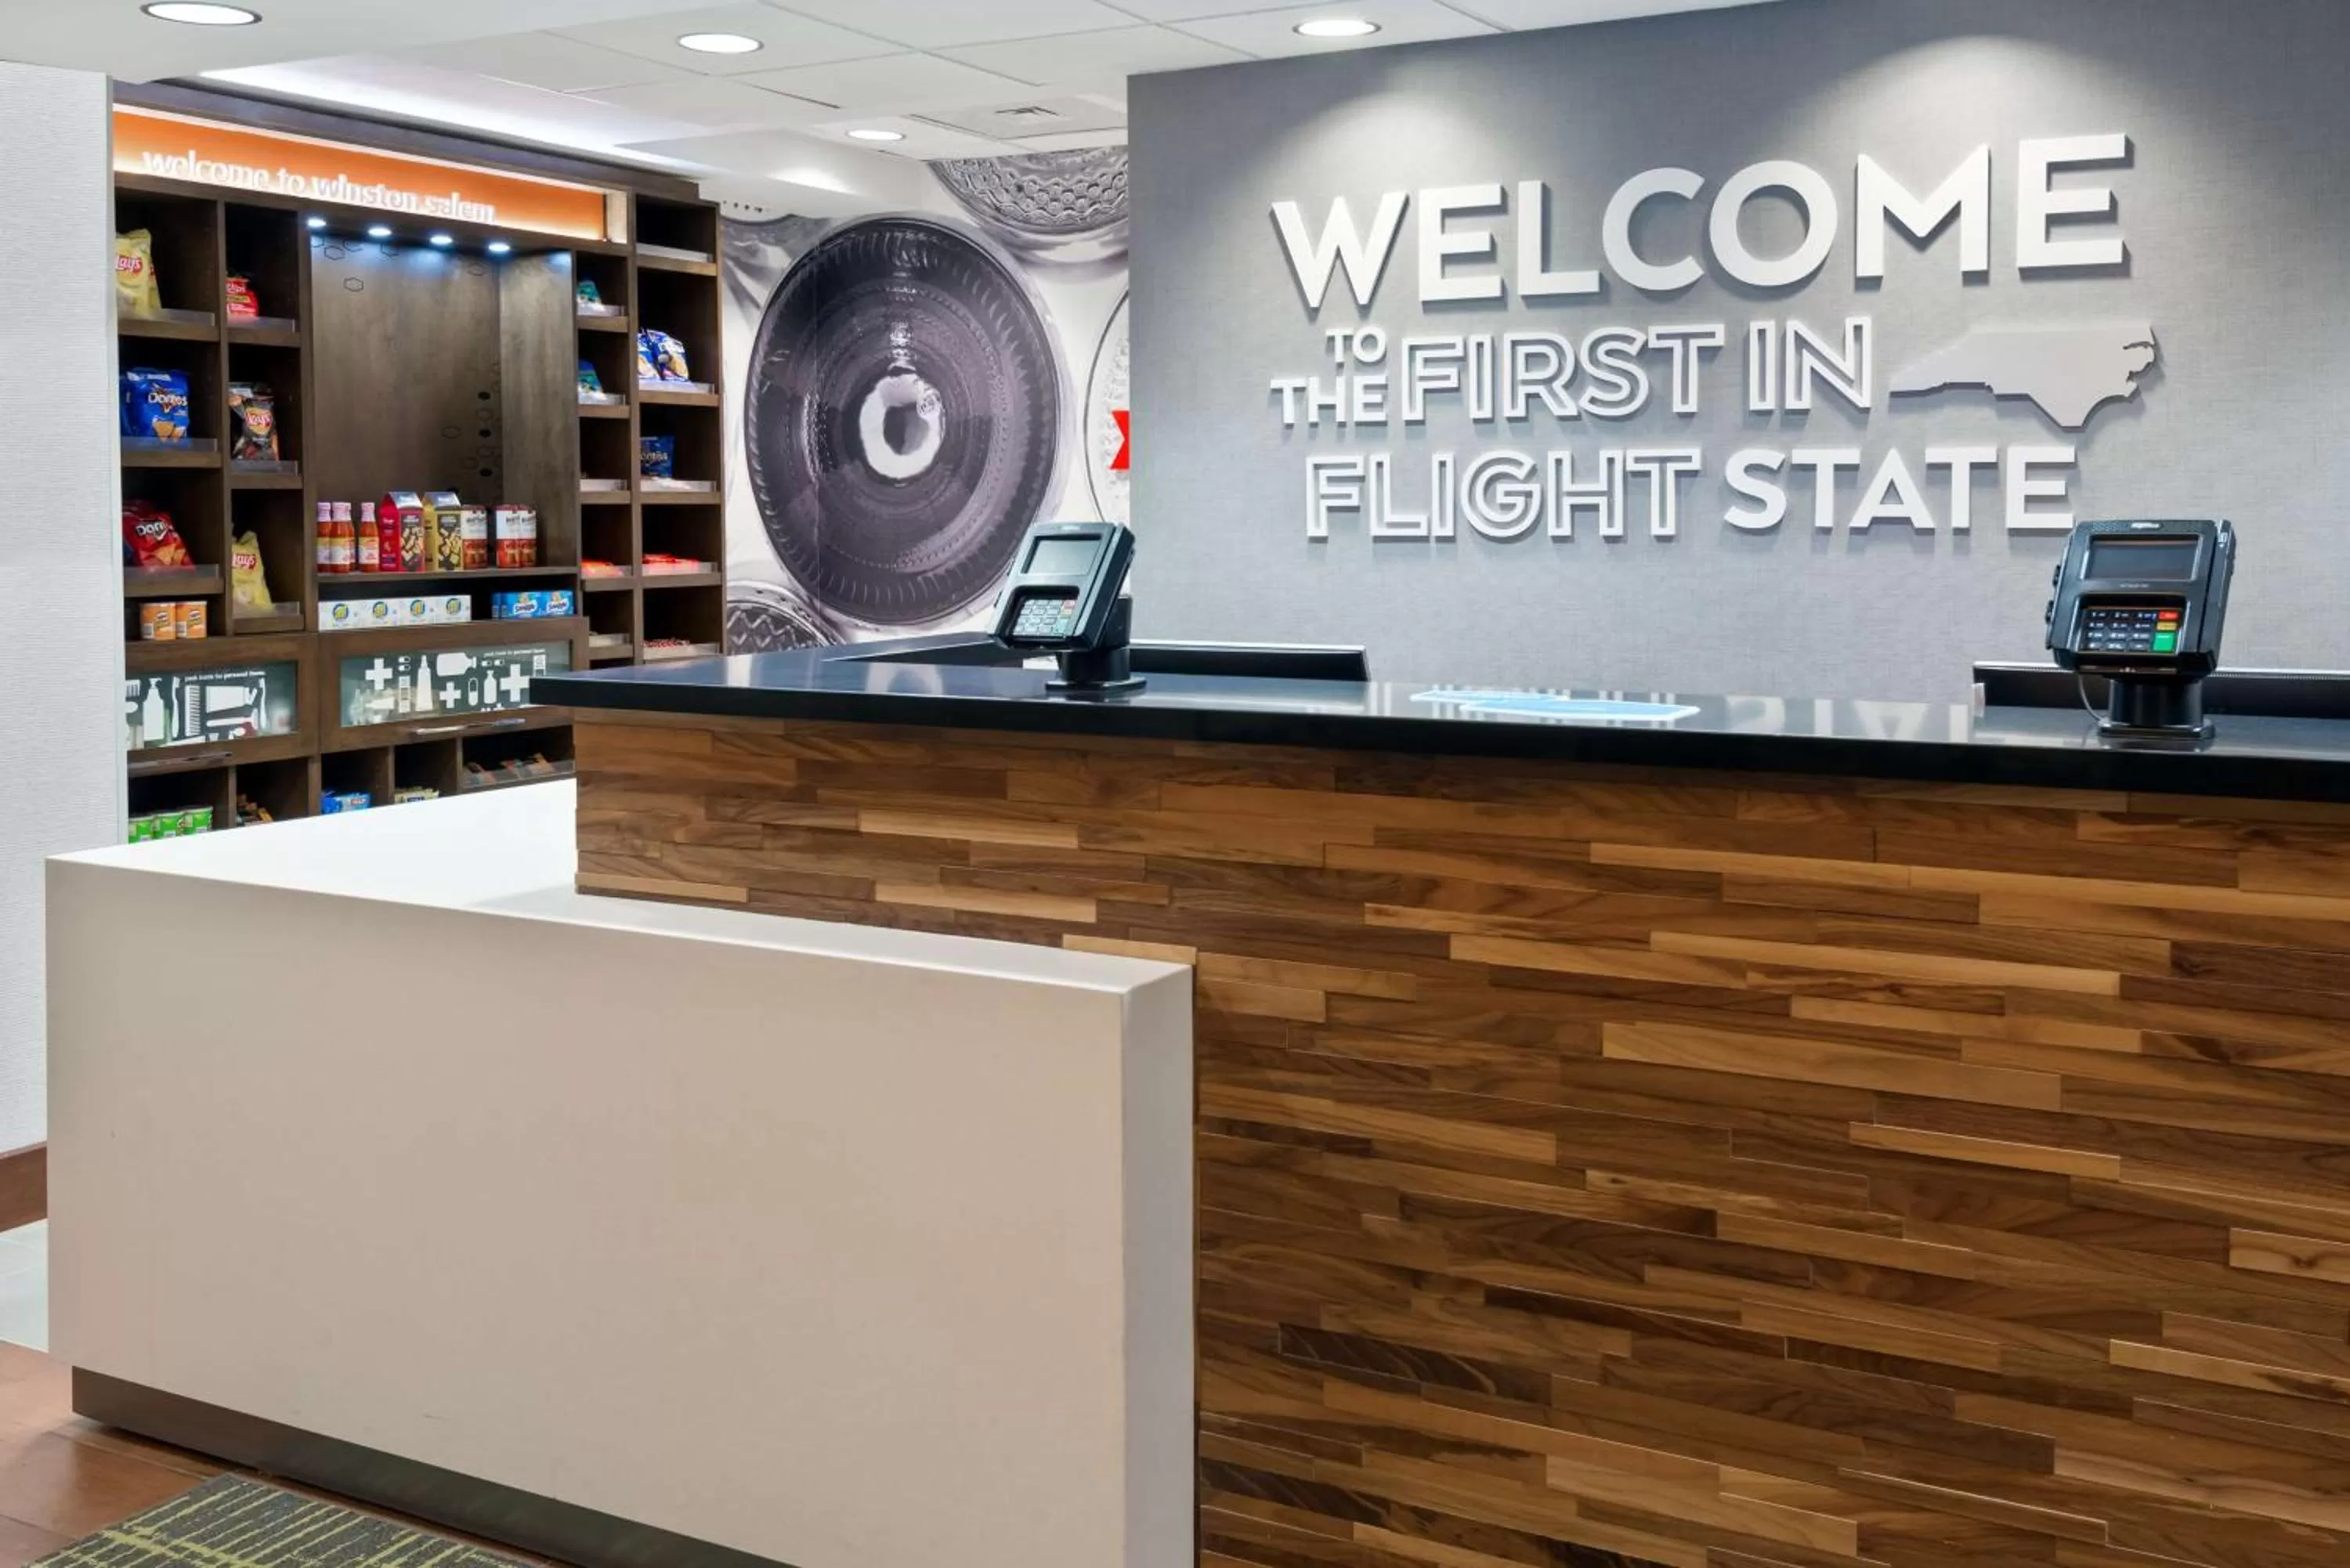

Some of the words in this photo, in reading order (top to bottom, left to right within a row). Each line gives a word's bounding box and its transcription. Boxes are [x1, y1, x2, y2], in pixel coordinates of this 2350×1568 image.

[142, 150, 269, 190] welcome
[278, 168, 306, 195] to
[311, 174, 418, 210] winston
[425, 192, 496, 222] salem
[1270, 133, 2129, 309] WELCOME
[1325, 325, 1387, 367] TO
[1401, 323, 1724, 423] FIRST
[1747, 316, 1873, 414] IN
[1269, 374, 1389, 426] THE
[1305, 449, 1701, 538] FLIGHT
[1723, 446, 2076, 531] STATE
